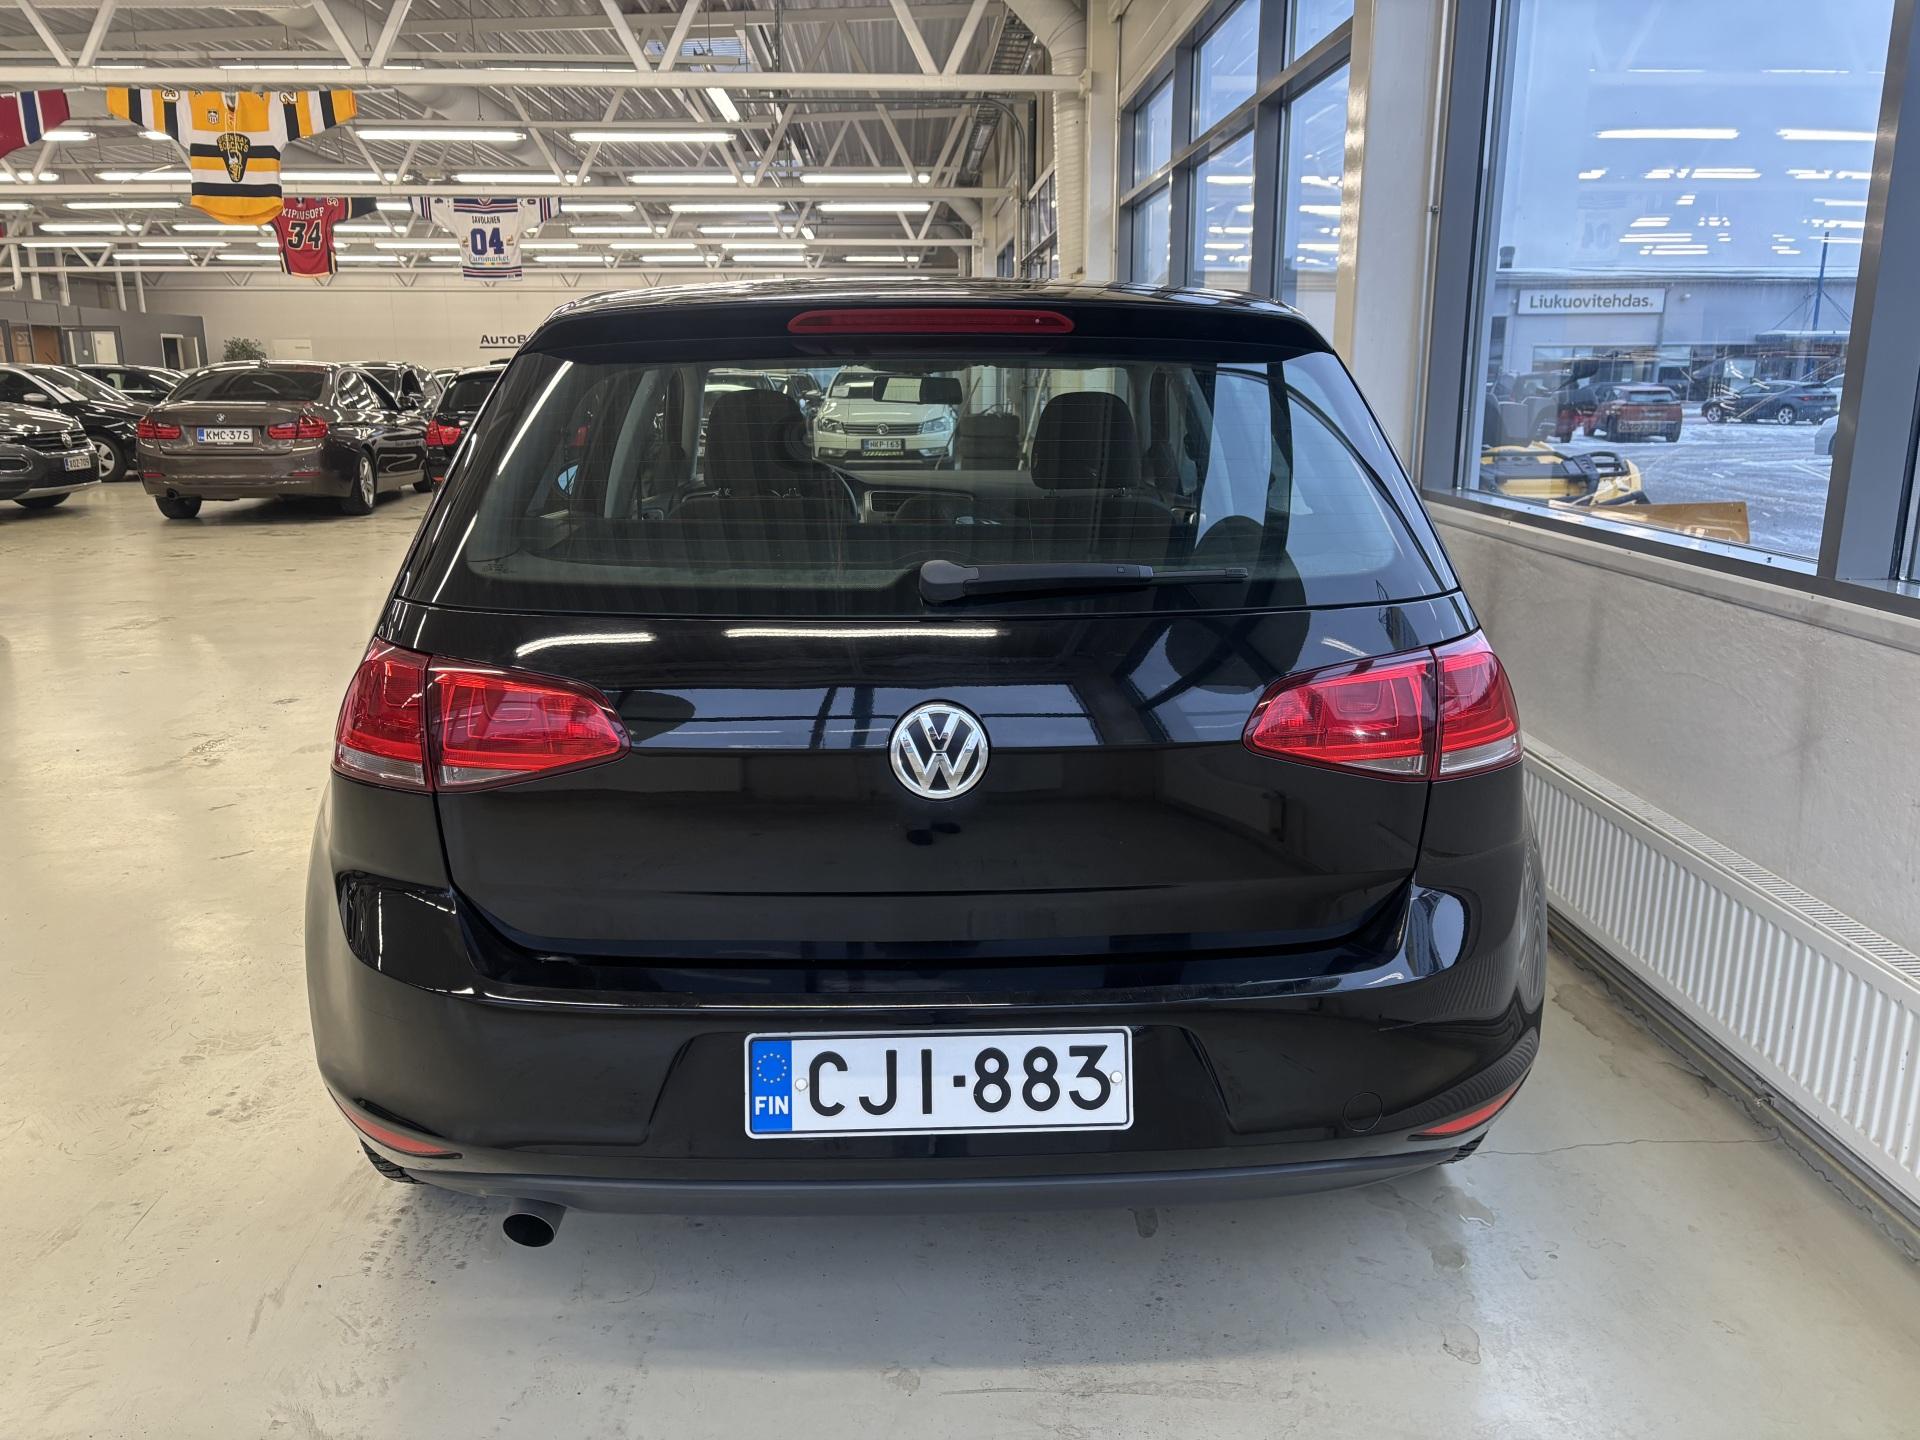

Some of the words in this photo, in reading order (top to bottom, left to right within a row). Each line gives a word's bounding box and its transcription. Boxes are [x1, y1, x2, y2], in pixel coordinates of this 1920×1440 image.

[287, 220, 322, 250] 34
[470, 227, 505, 255] 04
[206, 430, 250, 440] KMC-375
[808, 1045, 1111, 1117] CJI-883
[755, 1095, 789, 1116] FIN
